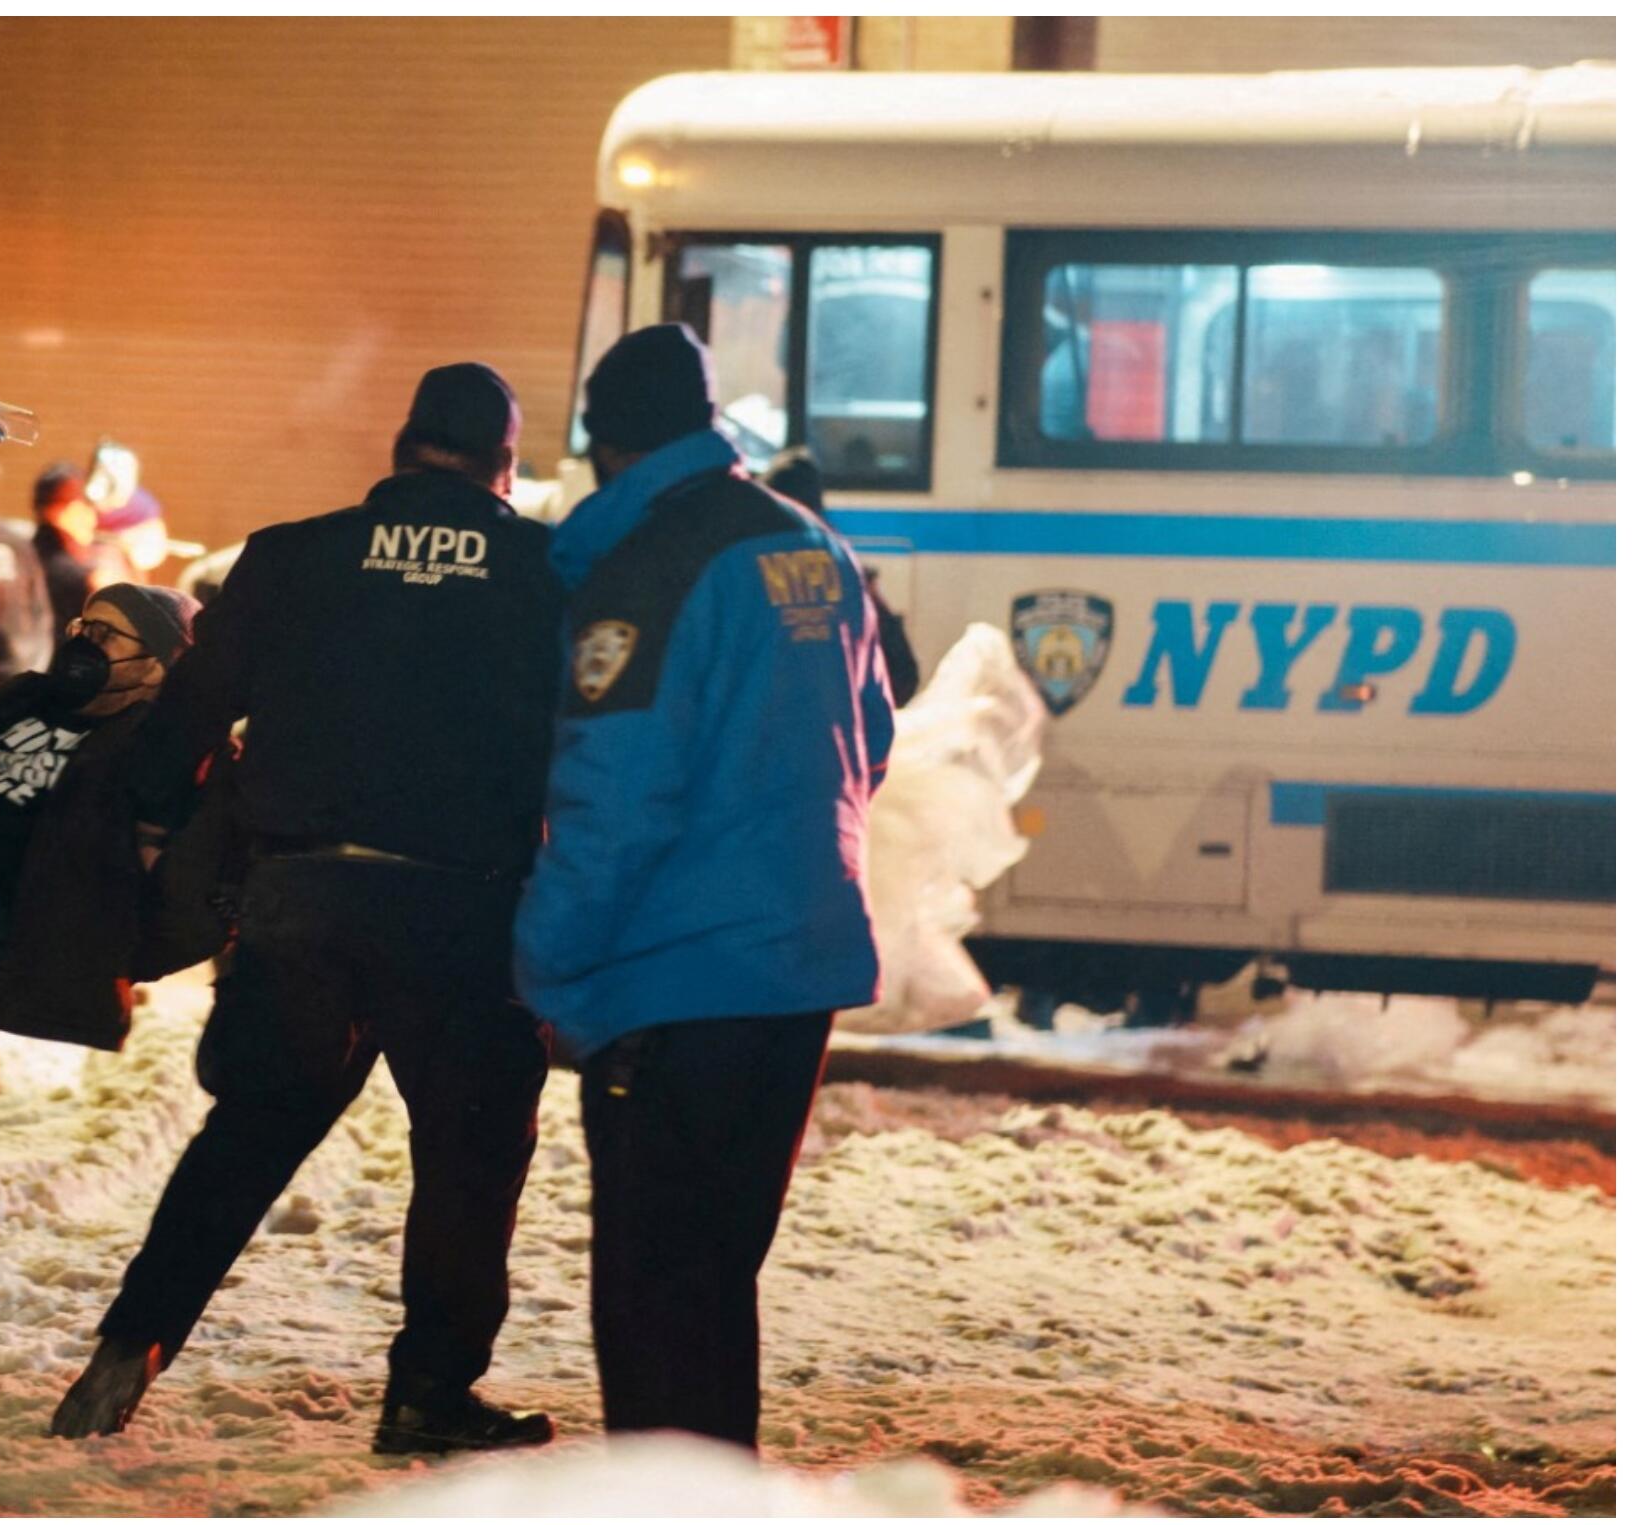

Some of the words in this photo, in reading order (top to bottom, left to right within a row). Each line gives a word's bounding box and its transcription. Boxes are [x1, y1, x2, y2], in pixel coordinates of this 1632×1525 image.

[370, 525, 486, 564] NYPD
[757, 550, 842, 606] NYPD
[1122, 600, 1518, 715] NYPD
